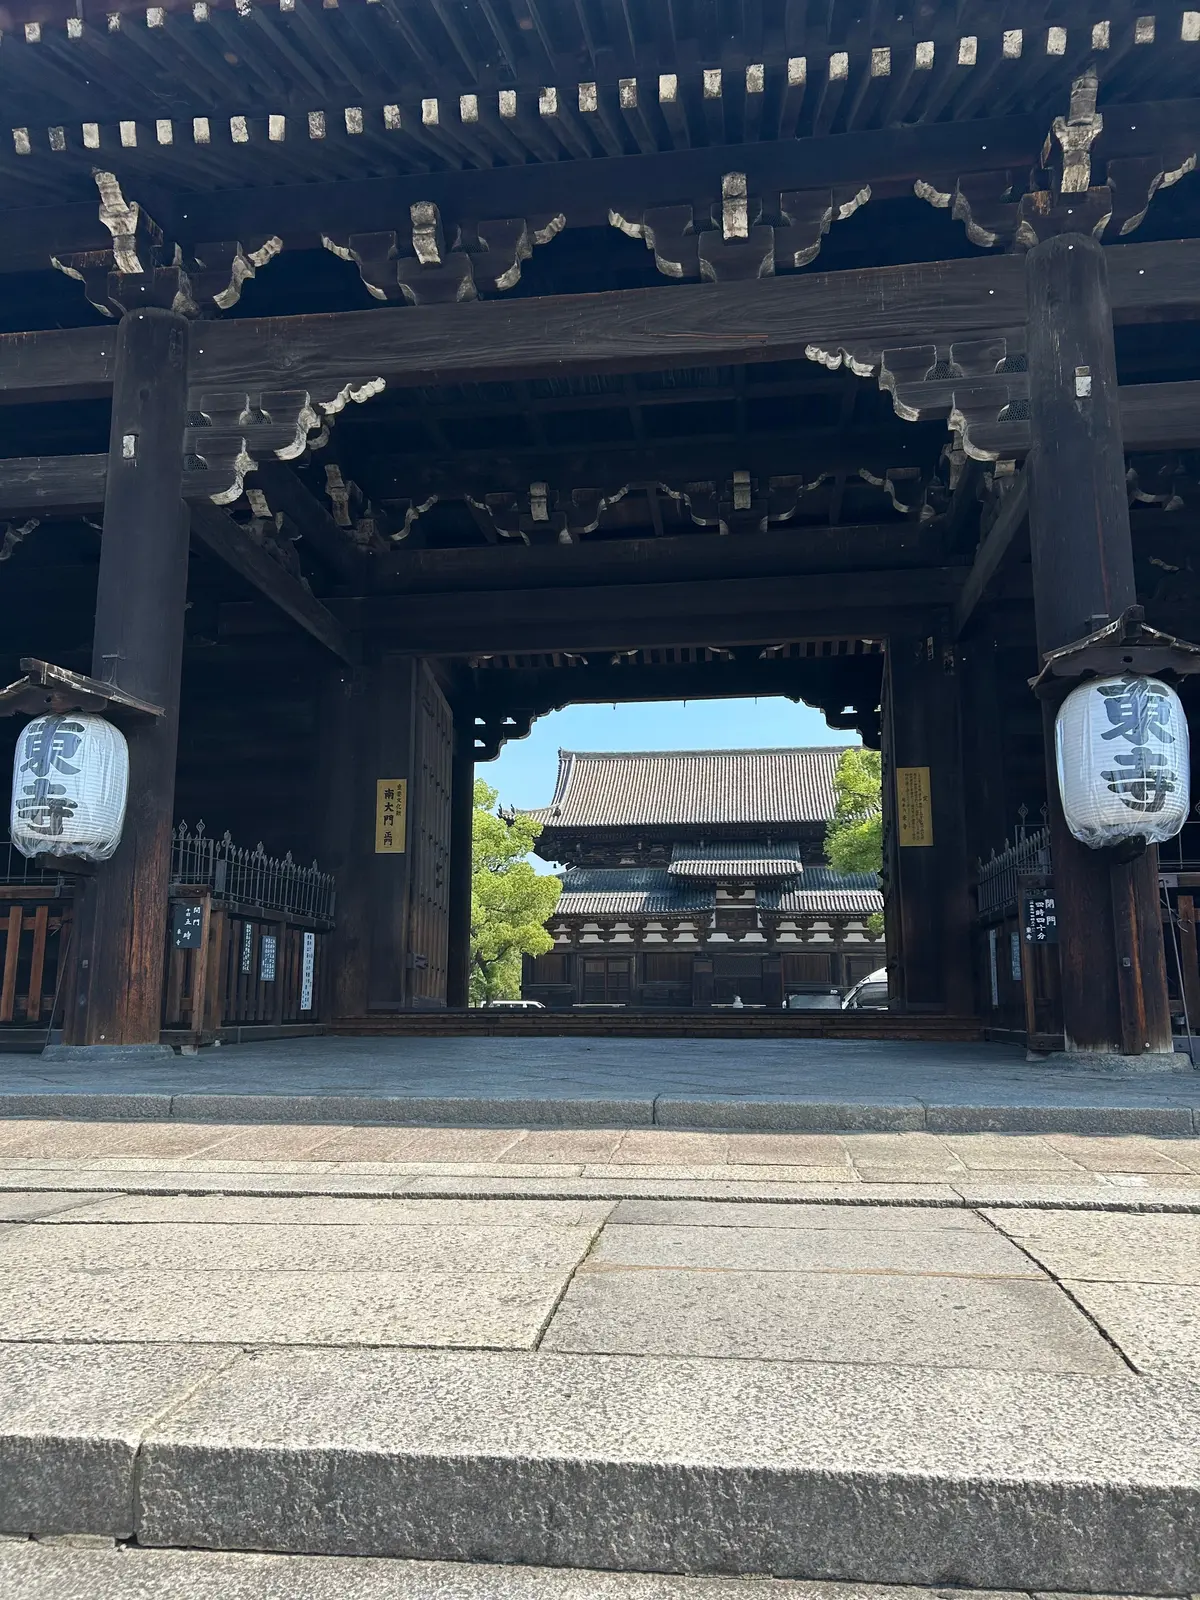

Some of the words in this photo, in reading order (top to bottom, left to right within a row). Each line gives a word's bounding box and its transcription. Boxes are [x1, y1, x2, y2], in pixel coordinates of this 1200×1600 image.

[1097, 676, 1177, 813] 東寺
[16, 717, 85, 836] 東寺
[383, 788, 395, 827] 南大門
[383, 831, 393, 846] 正門
[193, 906, 201, 926] 開門
[1035, 901, 1046, 940] 四時四十分
[1045, 899, 1056, 926] 閉門
